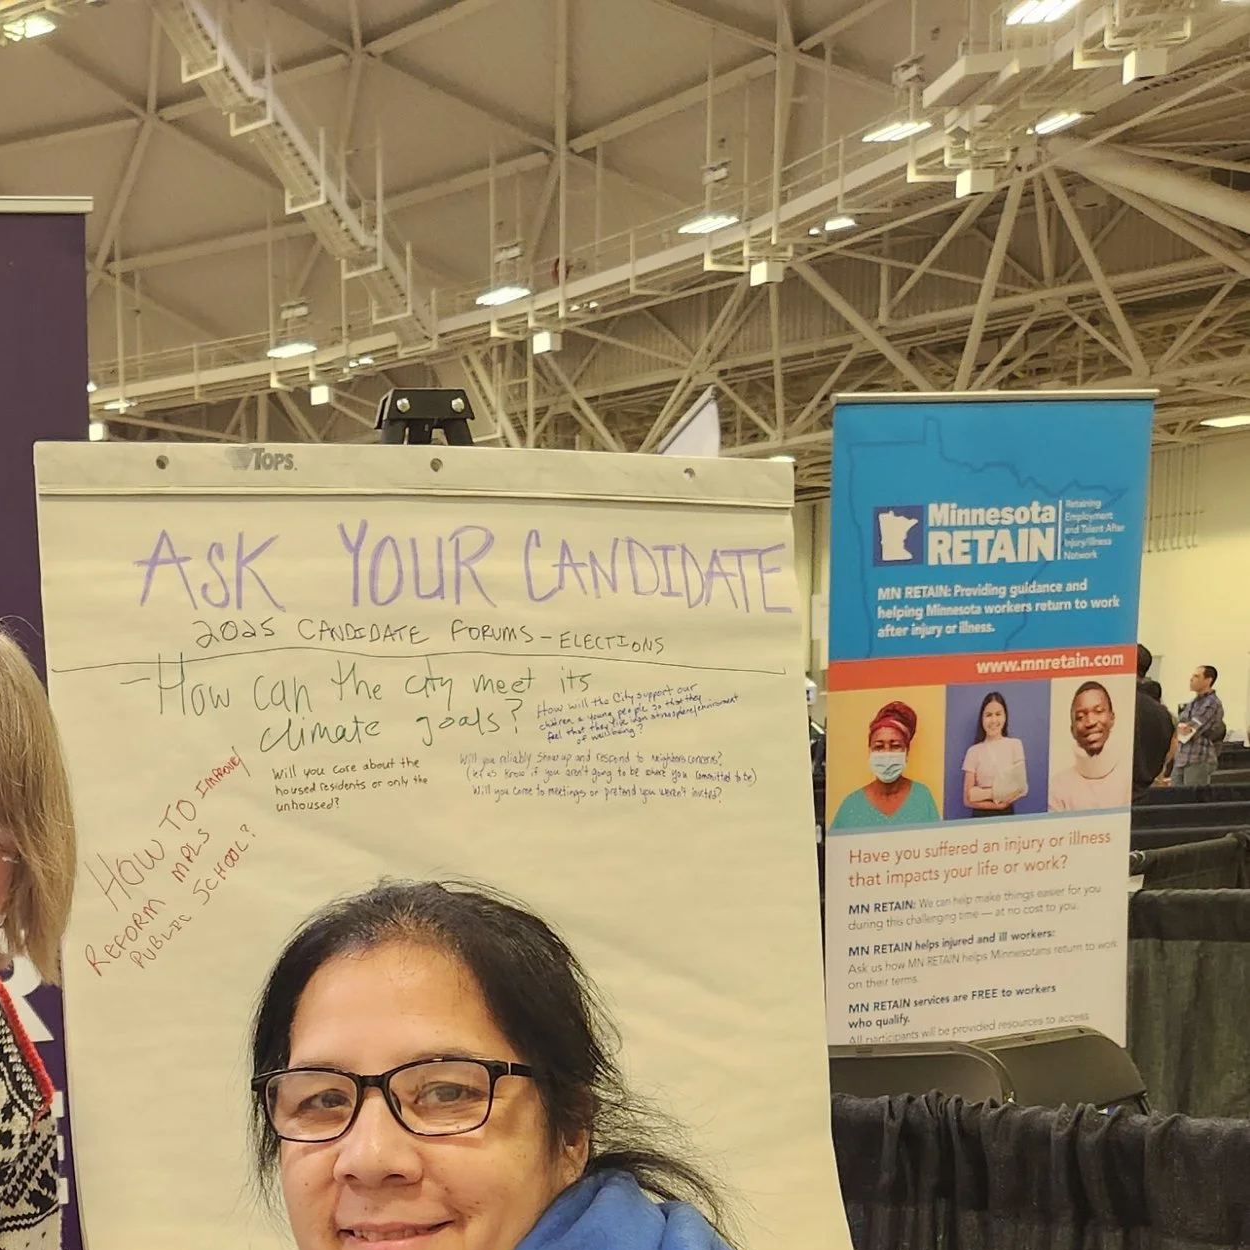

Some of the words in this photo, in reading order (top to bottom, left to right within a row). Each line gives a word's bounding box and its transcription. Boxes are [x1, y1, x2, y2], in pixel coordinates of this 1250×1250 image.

[928, 501, 1056, 526] Minnesota
[928, 528, 1055, 565] RETAIN
[133, 529, 286, 612] ASK
[337, 519, 496, 607] YOUR
[524, 529, 792, 613] CANDIDATE
[878, 588, 900, 600] MN
[905, 585, 951, 599] RETAIN:
[954, 583, 1006, 598] Providing
[1010, 580, 1062, 596] guidance
[1066, 579, 1087, 592] and
[878, 606, 923, 621] helping
[926, 603, 981, 616] Minnesota
[984, 600, 1032, 614] workers
[1035, 599, 1071, 611] return
[1075, 599, 1087, 610] to
[1091, 596, 1119, 609] work
[192, 617, 275, 648] 2025
[298, 619, 429, 644] CANDIDATE
[451, 619, 534, 643] FORUMS
[560, 631, 664, 654] ELECTIONS
[878, 623, 908, 638] after
[911, 623, 942, 638] injury
[945, 623, 957, 634] or
[959, 621, 995, 634] illness.
[977, 652, 1124, 673] www.mnretain.com
[157, 652, 230, 716] How
[253, 675, 312, 713] can
[330, 660, 382, 701] the
[473, 667, 536, 694] meet
[561, 666, 592, 693] its
[260, 715, 381, 752] climate
[416, 698, 522, 746] goals?
[272, 764, 297, 780] Will
[304, 768, 325, 778] you
[333, 764, 357, 775] care
[363, 758, 395, 770] about
[400, 757, 419, 768] the
[275, 783, 315, 796] housed
[320, 780, 365, 791] residents
[389, 776, 408, 787] only
[414, 775, 428, 784] the
[276, 797, 340, 812] unhoused?
[84, 839, 165, 912] HOW
[159, 800, 196, 830] TO
[849, 849, 889, 864] Have
[895, 849, 921, 865] you
[925, 839, 978, 858] suffered
[983, 842, 999, 853] an
[1005, 836, 1044, 854] injury
[1050, 836, 1064, 847] or
[1070, 830, 1111, 846] illness
[849, 872, 881, 887] that
[887, 870, 940, 888] impacts
[944, 866, 972, 884] your
[977, 860, 998, 876] life
[1004, 862, 1020, 874] or
[1024, 854, 1068, 872] work?
[85, 899, 166, 976] REFORM
[171, 828, 209, 883] MPLS
[848, 904, 870, 915] MN
[874, 900, 916, 913] RETAIN:
[130, 915, 191, 969] PUBLIC
[848, 946, 870, 956] MN
[874, 942, 912, 954] RETAIN
[915, 939, 939, 951] helps
[942, 934, 974, 949] injured
[977, 933, 995, 943] and
[999, 932, 1007, 942] ill
[1011, 930, 1055, 941] workers:
[848, 1003, 869, 1013] MN
[873, 999, 911, 1011] RETAIN
[914, 996, 949, 1007] services
[953, 993, 968, 1002] are
[972, 989, 998, 1000] FREE
[1002, 989, 1012, 997] to
[1016, 984, 1056, 995] workers
[848, 1018, 872, 1029] who
[876, 1013, 910, 1028] qualify.
